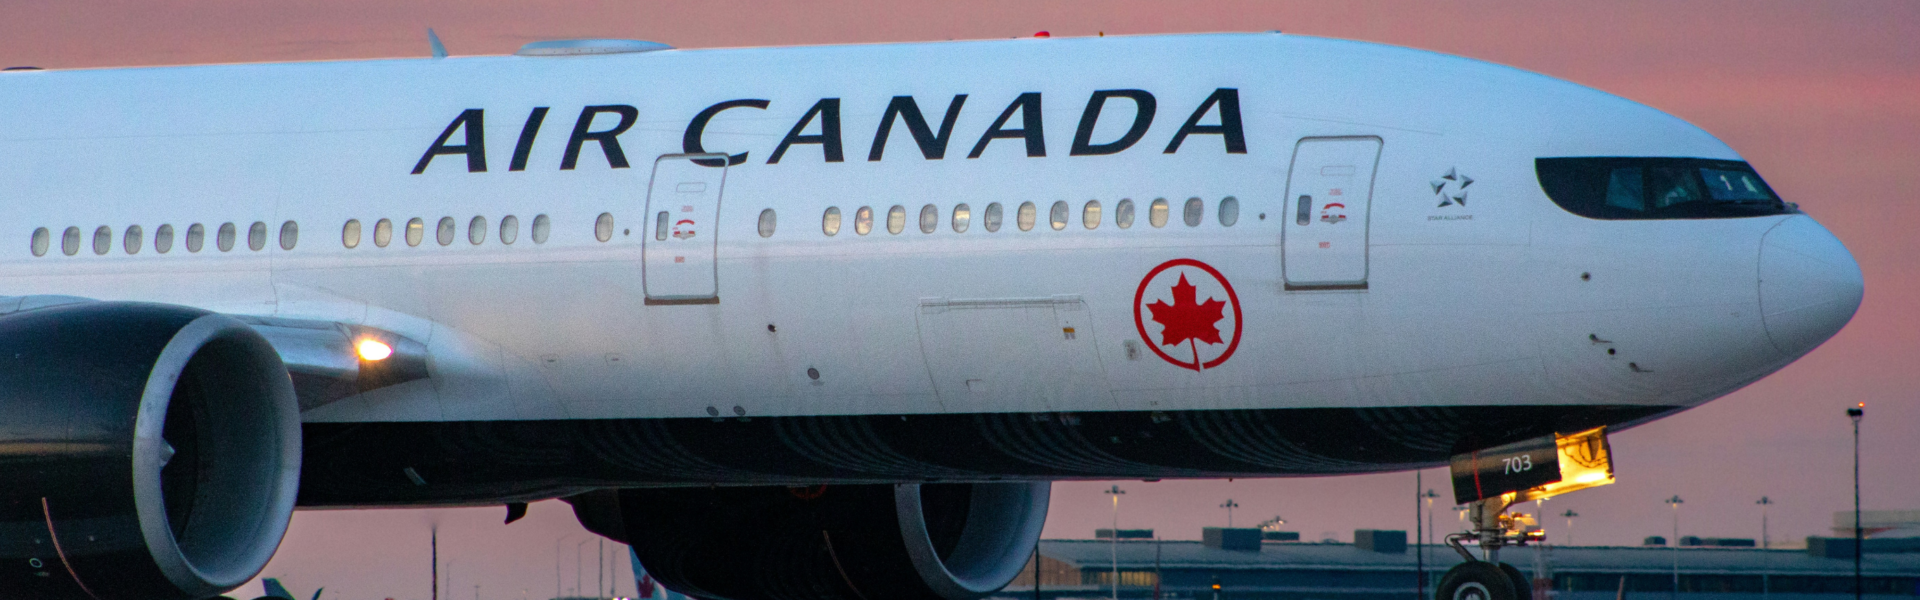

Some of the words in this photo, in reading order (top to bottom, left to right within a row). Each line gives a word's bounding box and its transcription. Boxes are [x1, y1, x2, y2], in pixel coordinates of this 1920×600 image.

[411, 104, 639, 175] AIR
[683, 88, 1248, 168] CANADA
[1501, 454, 1533, 475] 703
